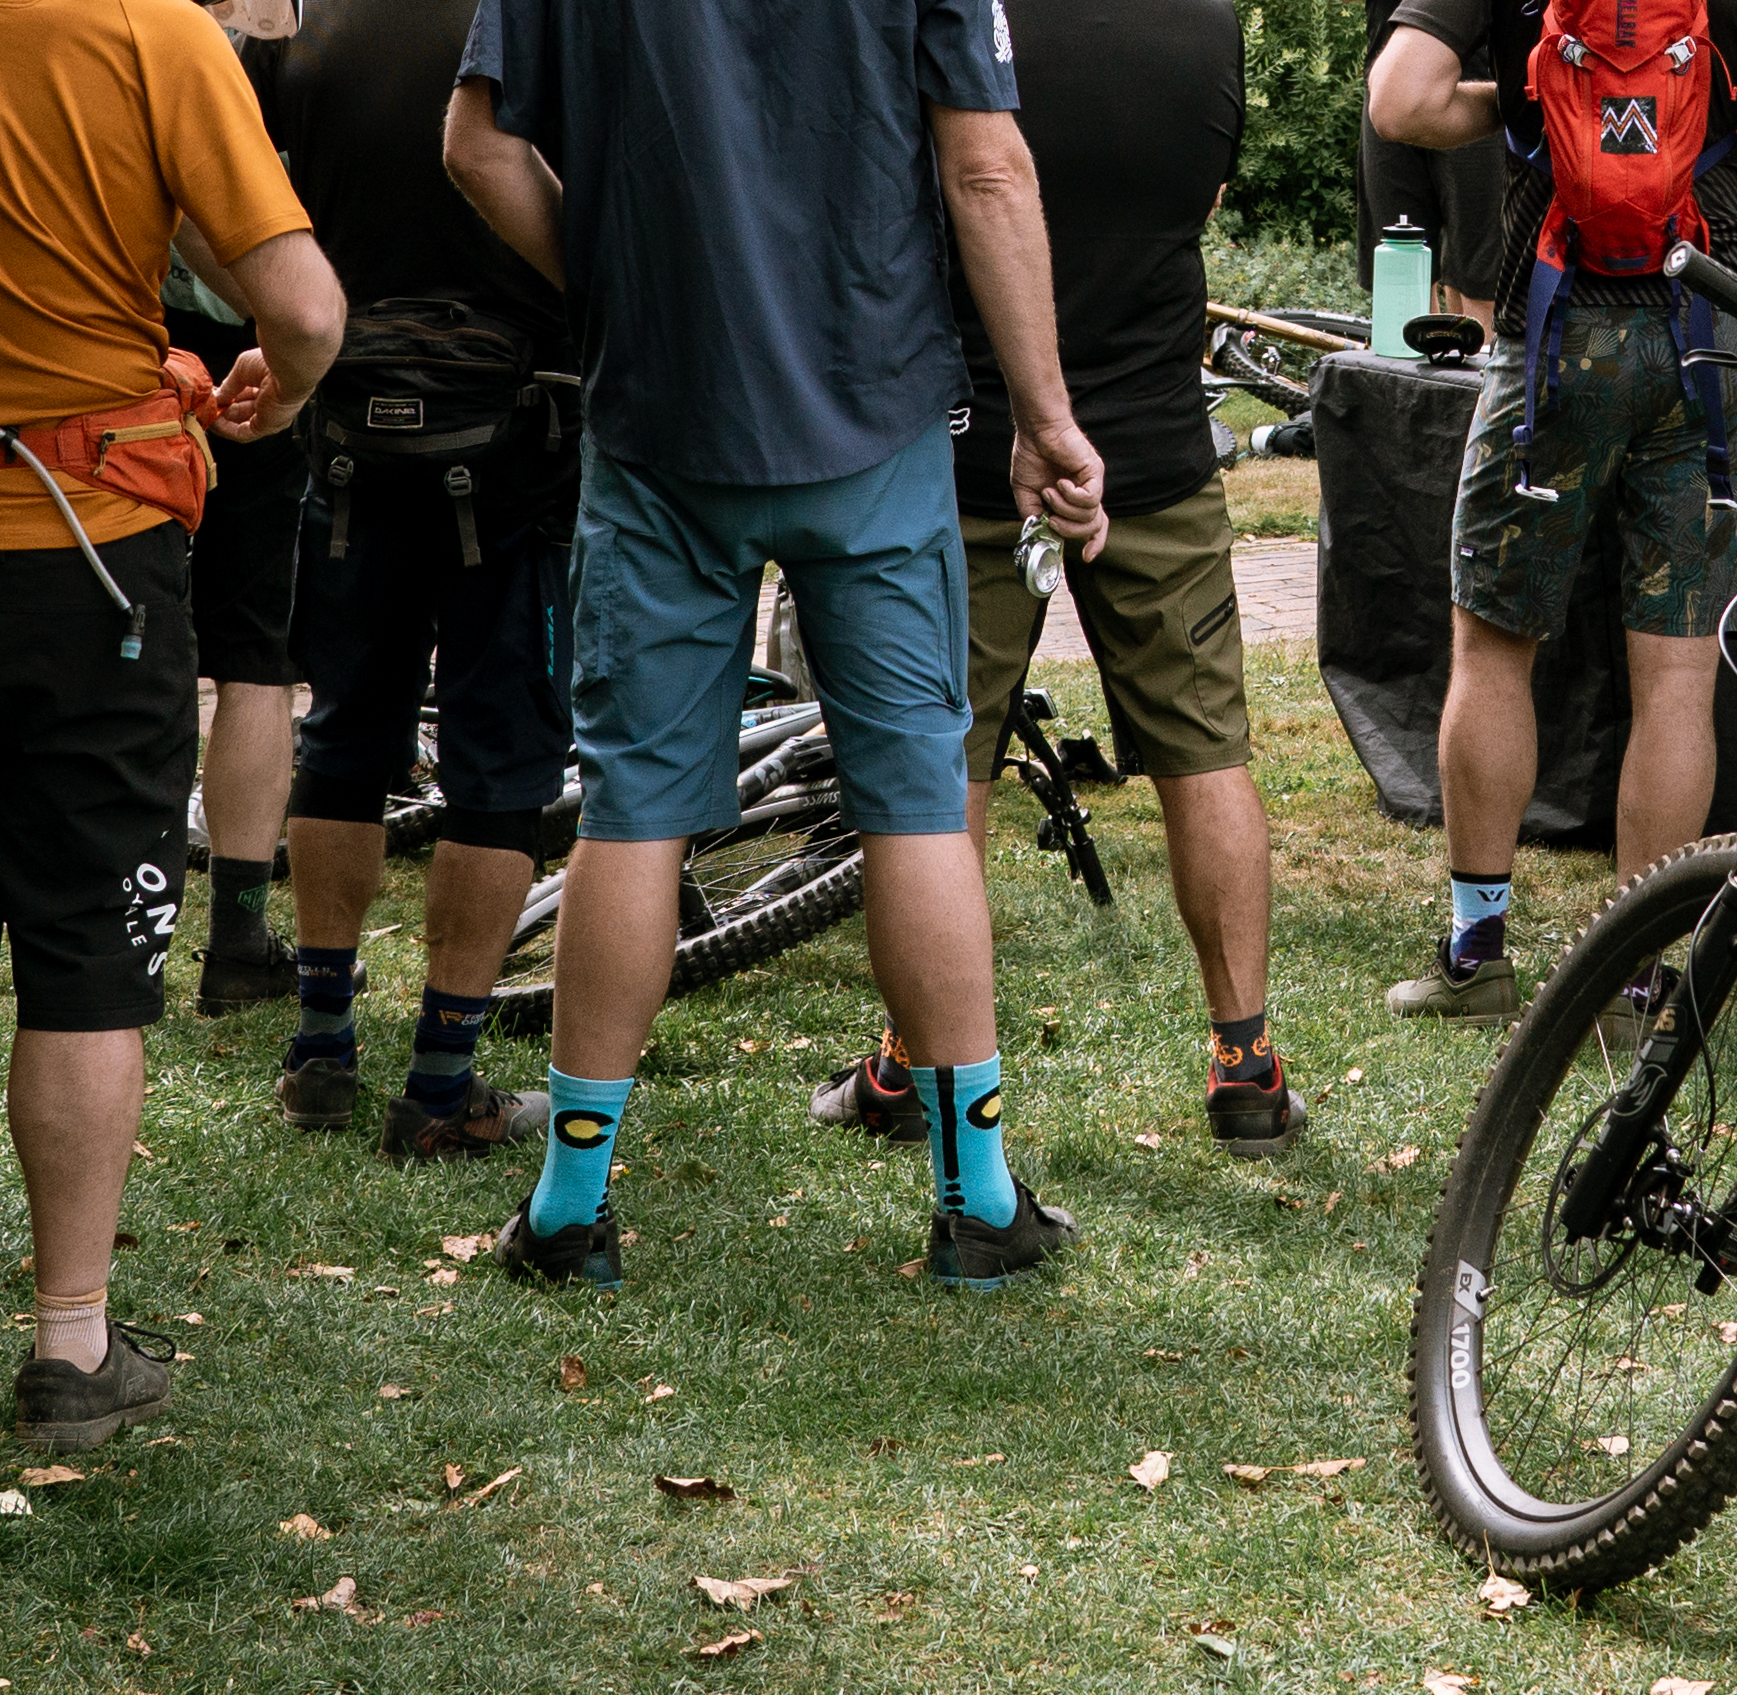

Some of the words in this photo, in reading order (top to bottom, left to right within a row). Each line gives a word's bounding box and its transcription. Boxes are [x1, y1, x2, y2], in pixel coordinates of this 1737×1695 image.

[122, 876, 149, 948] OYALE
[1458, 1272, 1475, 1296] EX
[1450, 1322, 1472, 1389] 1700
